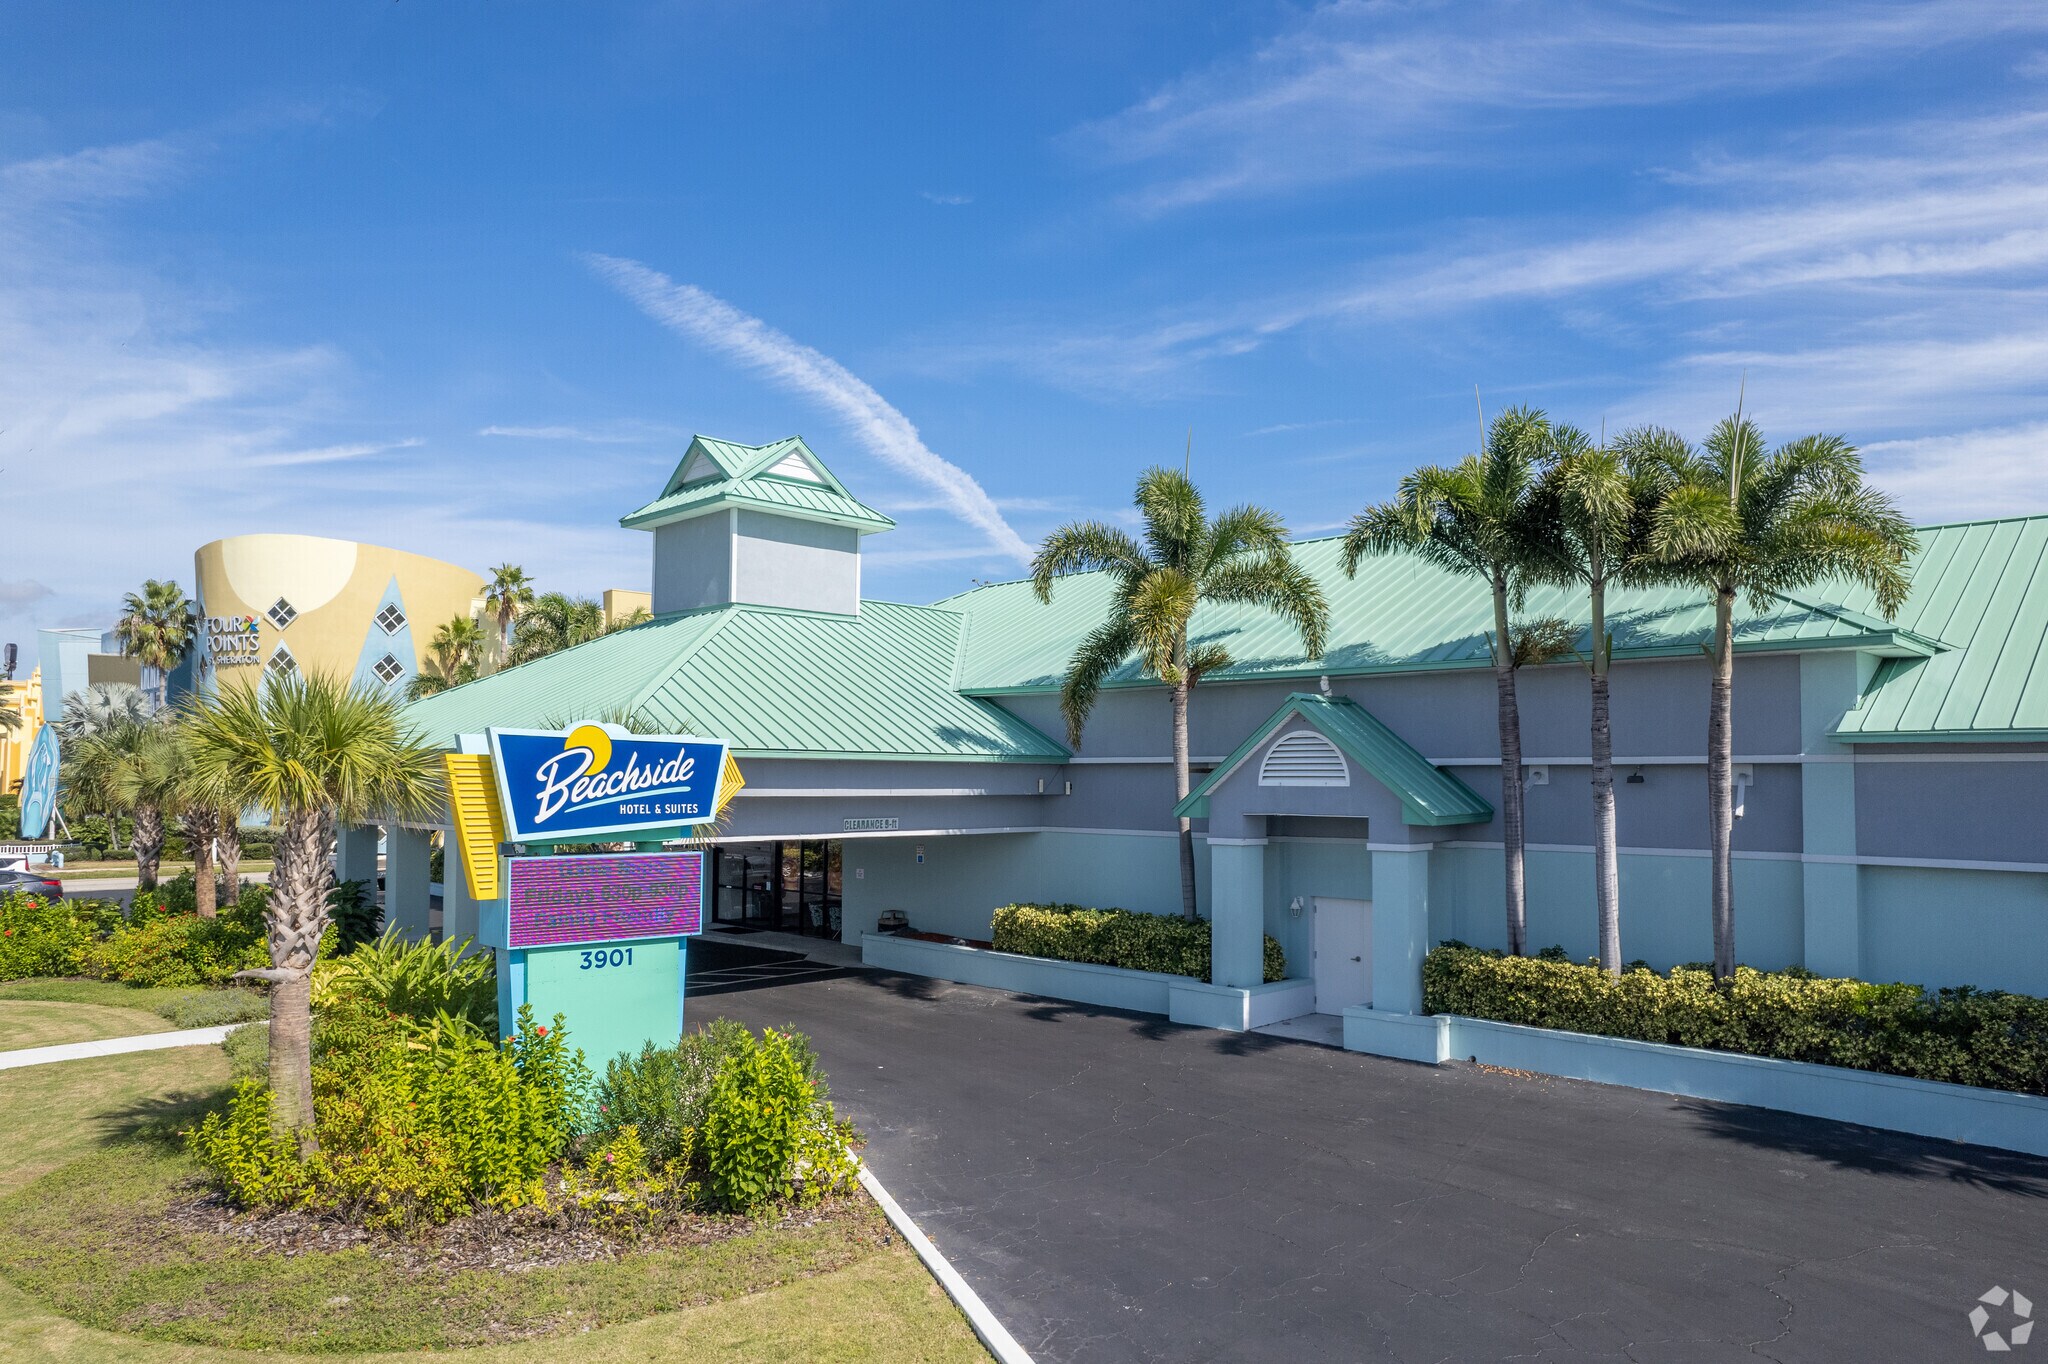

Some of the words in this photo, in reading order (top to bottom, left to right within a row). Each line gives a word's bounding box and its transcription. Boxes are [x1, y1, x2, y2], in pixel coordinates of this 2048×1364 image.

[205, 616, 243, 633] FOUR
[206, 634, 259, 652] POINTS
[216, 655, 260, 664] SHERATON
[534, 747, 695, 824] Beachside
[620, 804, 651, 814] HOTEL
[654, 804, 662, 814] &
[664, 803, 699, 814] SUITES
[844, 819, 884, 830] CLEARANCE
[579, 948, 633, 970] 3901
